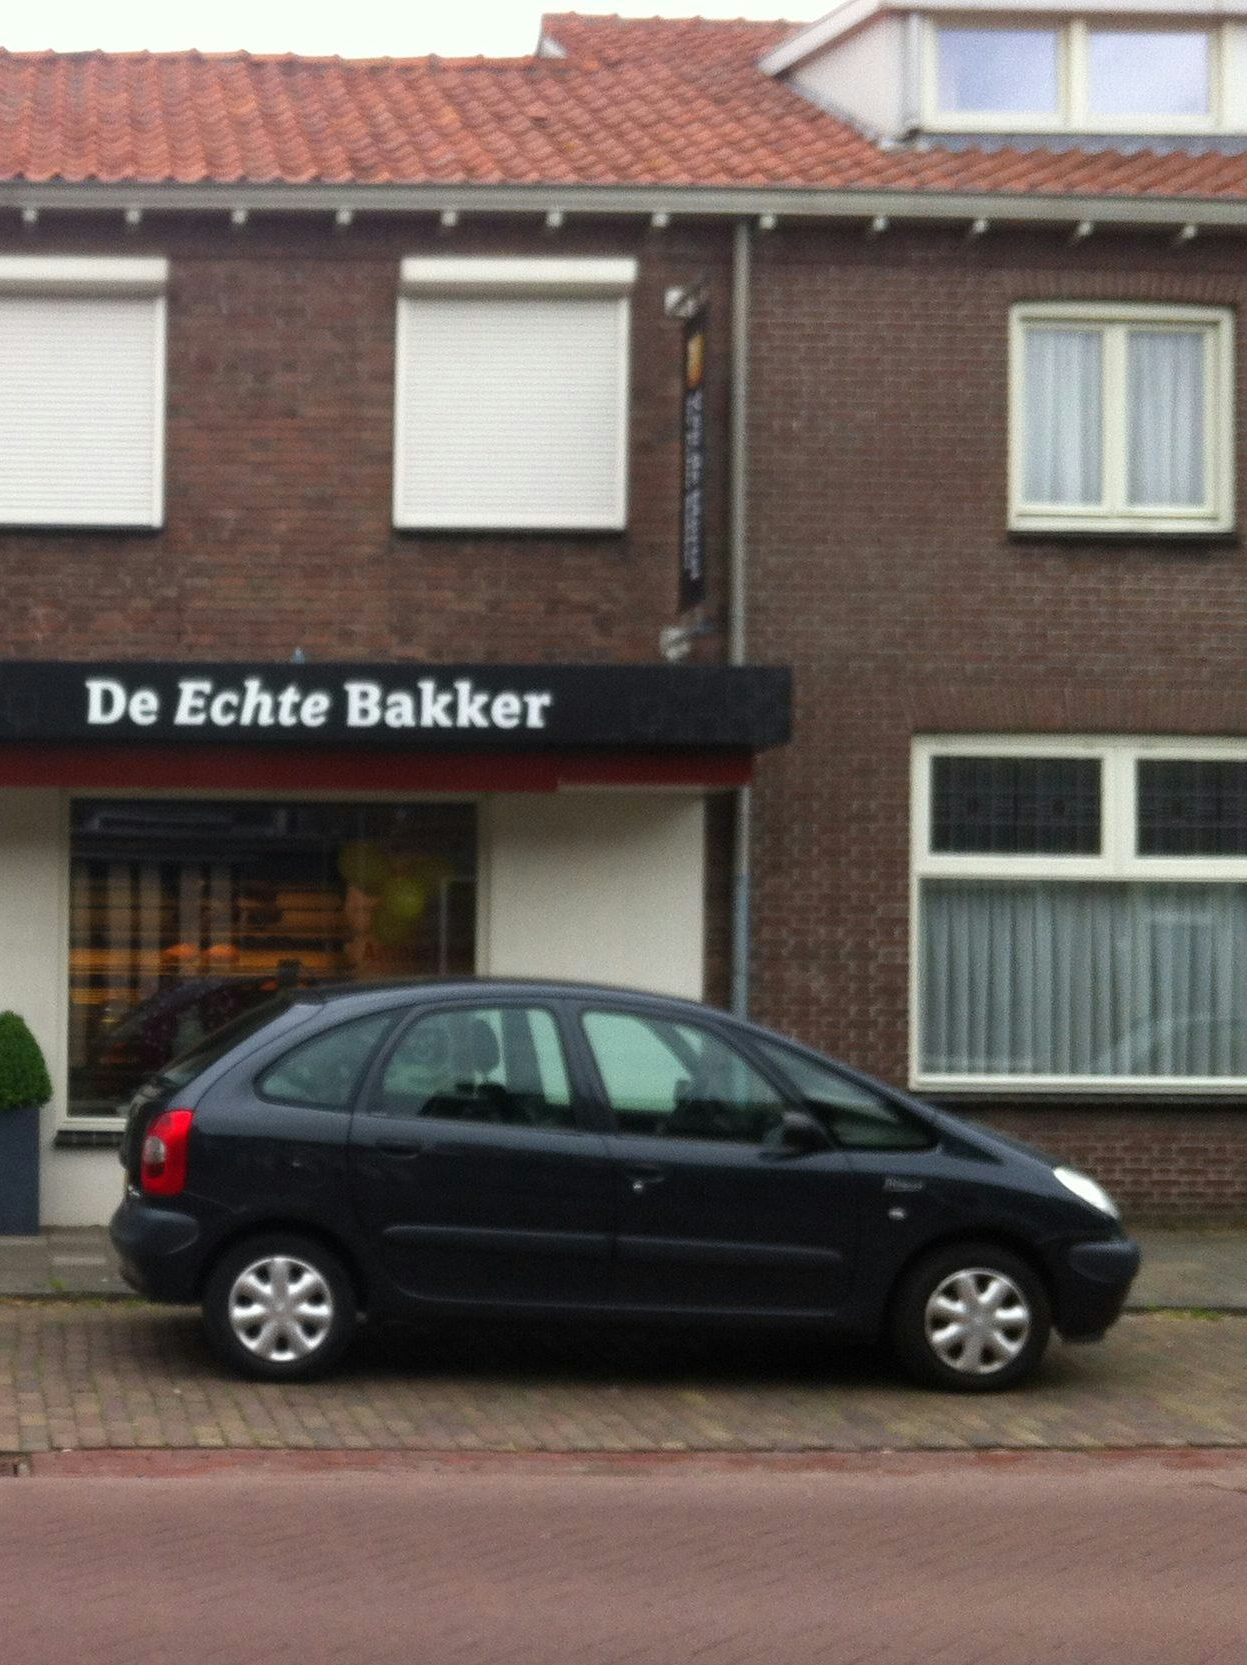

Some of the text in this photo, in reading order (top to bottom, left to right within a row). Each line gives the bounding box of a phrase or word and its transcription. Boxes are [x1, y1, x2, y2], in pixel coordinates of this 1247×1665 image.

[85, 679, 552, 728] De Echte Bakker
